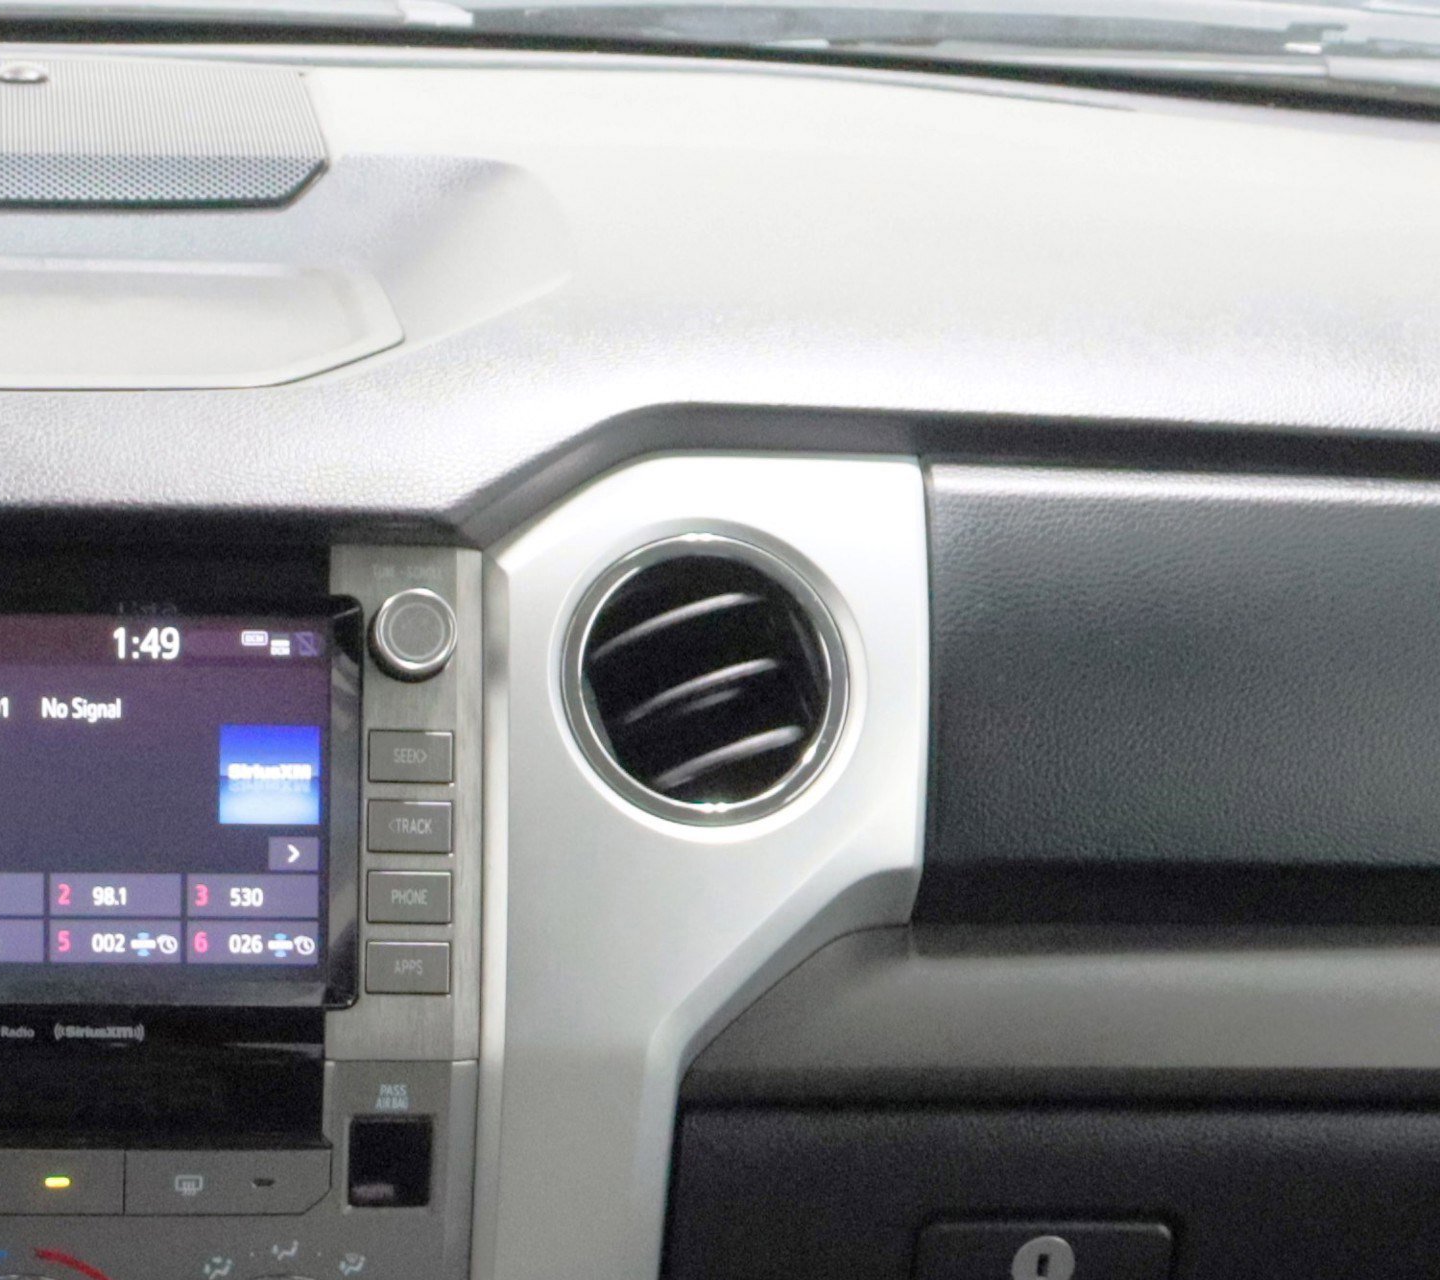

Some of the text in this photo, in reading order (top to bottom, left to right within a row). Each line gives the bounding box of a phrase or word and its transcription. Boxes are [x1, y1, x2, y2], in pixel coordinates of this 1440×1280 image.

[113, 626, 180, 659] 1:49
[41, 697, 121, 723] No Signal
[57, 884, 127, 906] 2 98.1
[194, 884, 264, 906] 3 530
[391, 888, 428, 905] PHONE
[58, 931, 125, 952] 5 002
[194, 932, 263, 953] 6 026
[394, 959, 424, 976] APPS
[380, 1084, 407, 1096] PASS
